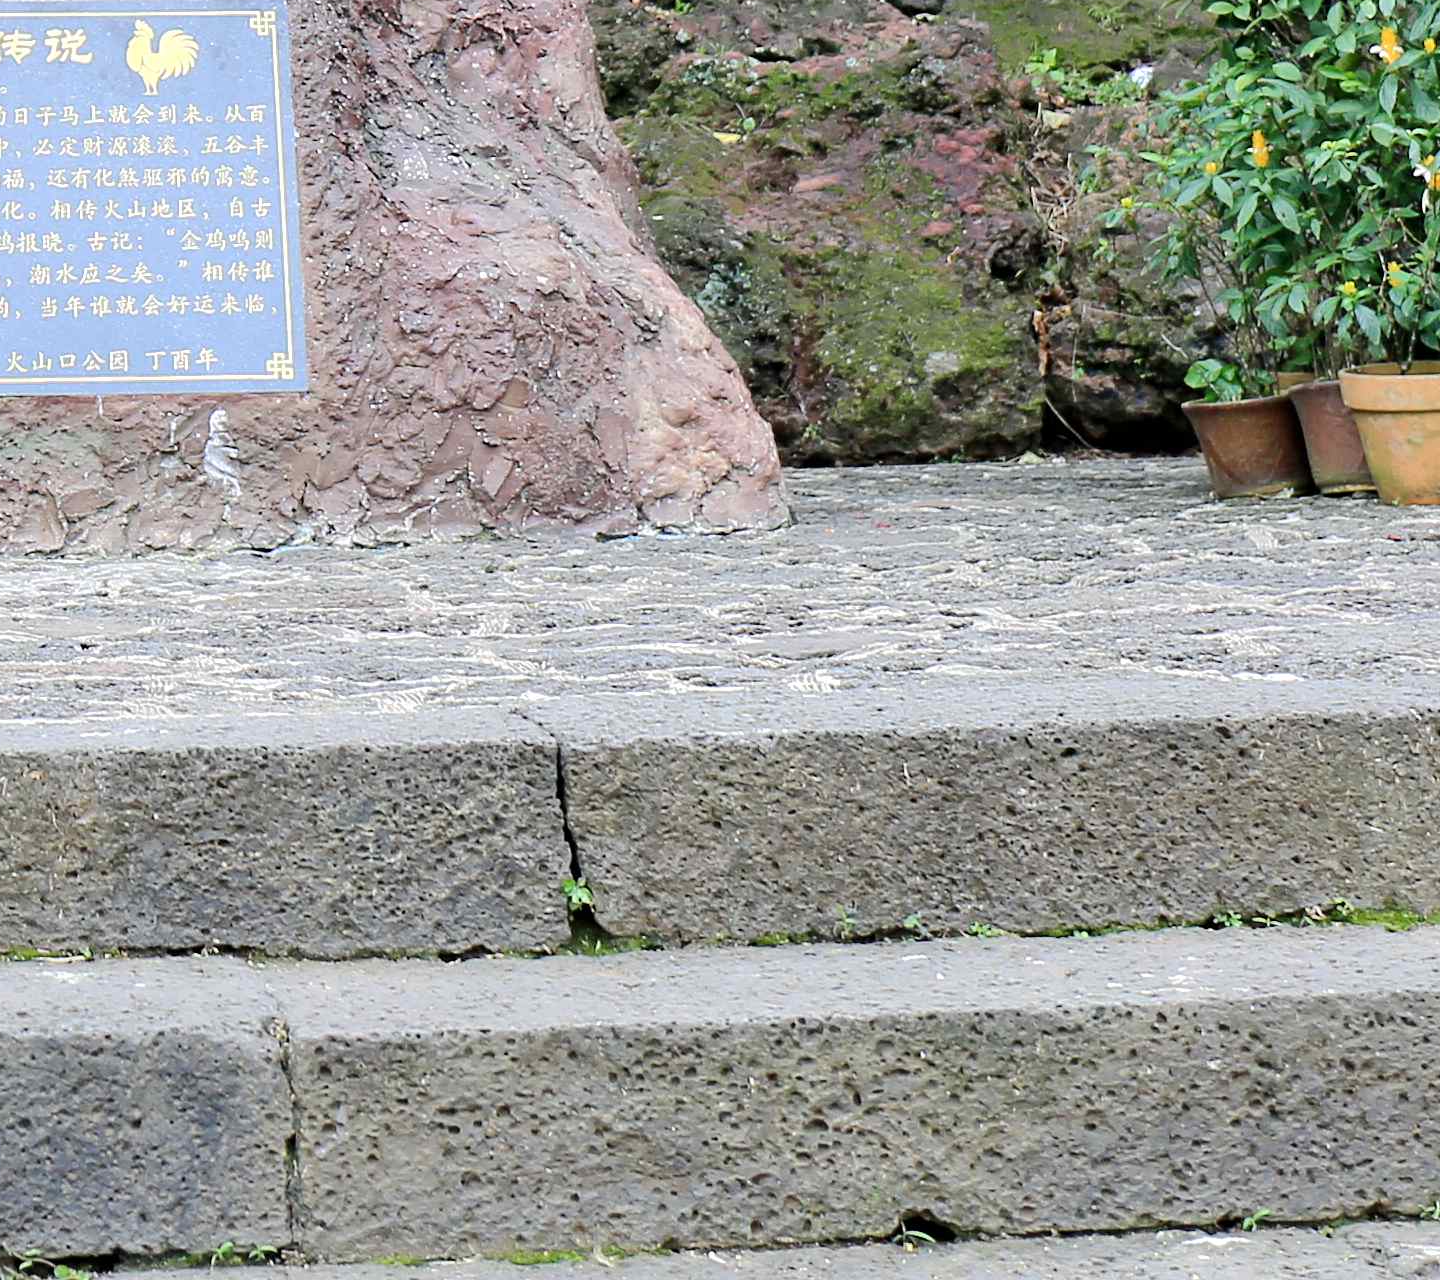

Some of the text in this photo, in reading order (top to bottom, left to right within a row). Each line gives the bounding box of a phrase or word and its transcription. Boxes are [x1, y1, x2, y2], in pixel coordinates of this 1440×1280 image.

[6, 348, 219, 372] 火山口公园 丁酉年
